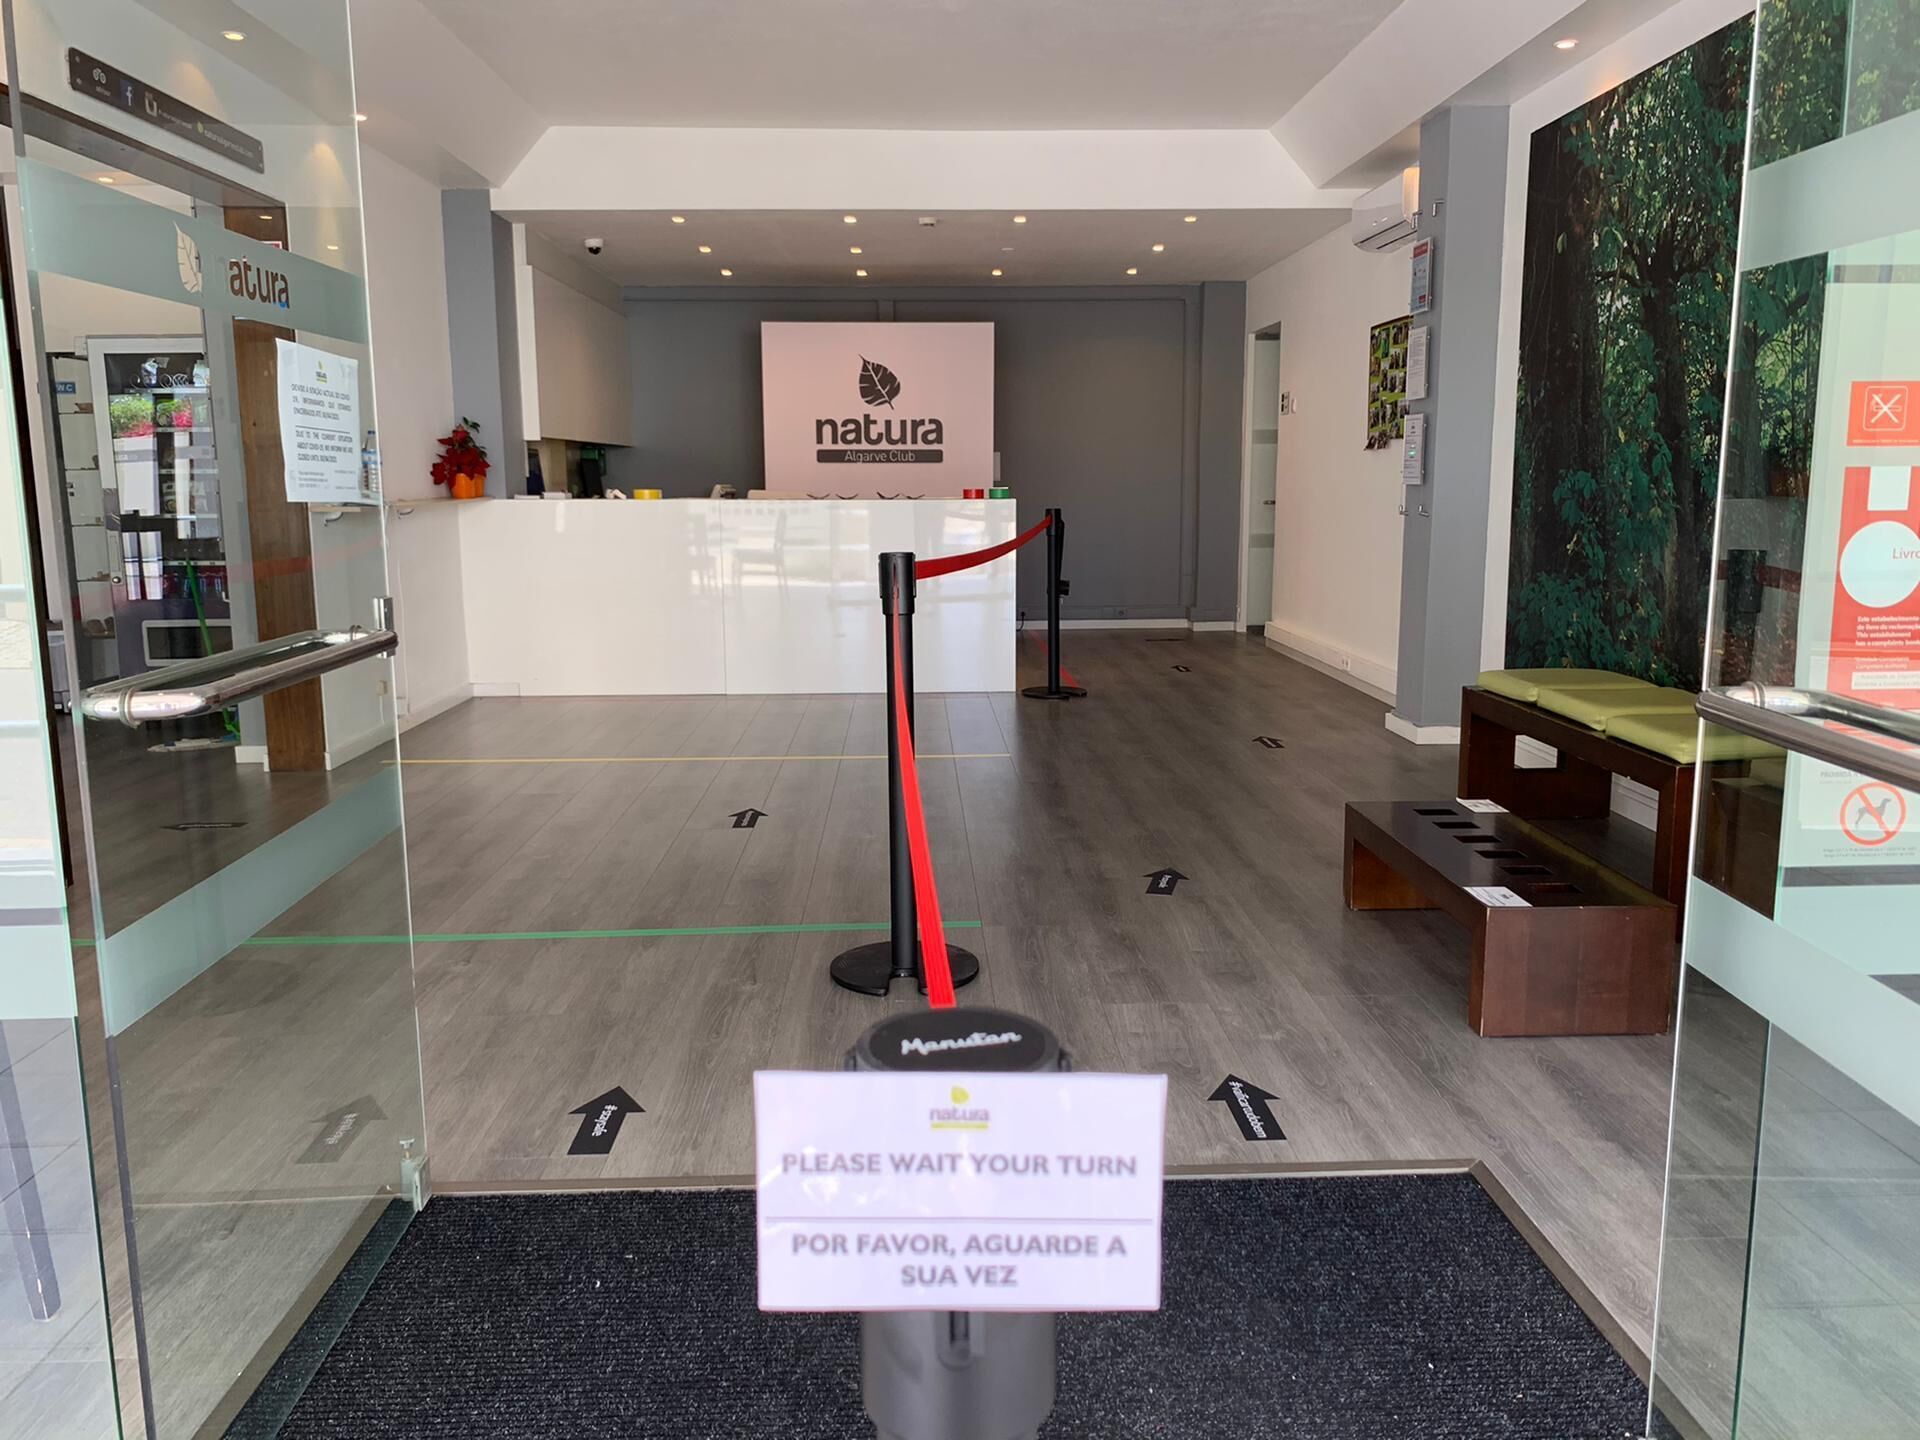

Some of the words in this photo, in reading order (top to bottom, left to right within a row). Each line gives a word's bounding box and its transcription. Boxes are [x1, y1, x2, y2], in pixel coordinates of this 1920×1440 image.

[227, 256, 290, 309] atura
[816, 414, 943, 445] natura
[844, 450, 887, 463] Algarve
[889, 450, 916, 462] Club
[901, 1030, 1022, 1056] Manutan
[930, 1106, 989, 1122] natura
[782, 1153, 881, 1174] PLEASE
[889, 1153, 963, 1175] WAIT
[969, 1154, 1048, 1175] YOUR
[1056, 1154, 1137, 1176] TURN
[791, 1234, 847, 1256] POR
[857, 1234, 956, 1257] FAVOR,
[964, 1234, 1098, 1256] AGUARDE
[1106, 1235, 1127, 1256] A
[901, 1265, 958, 1287] SUA
[965, 1265, 1017, 1287] VEZ
